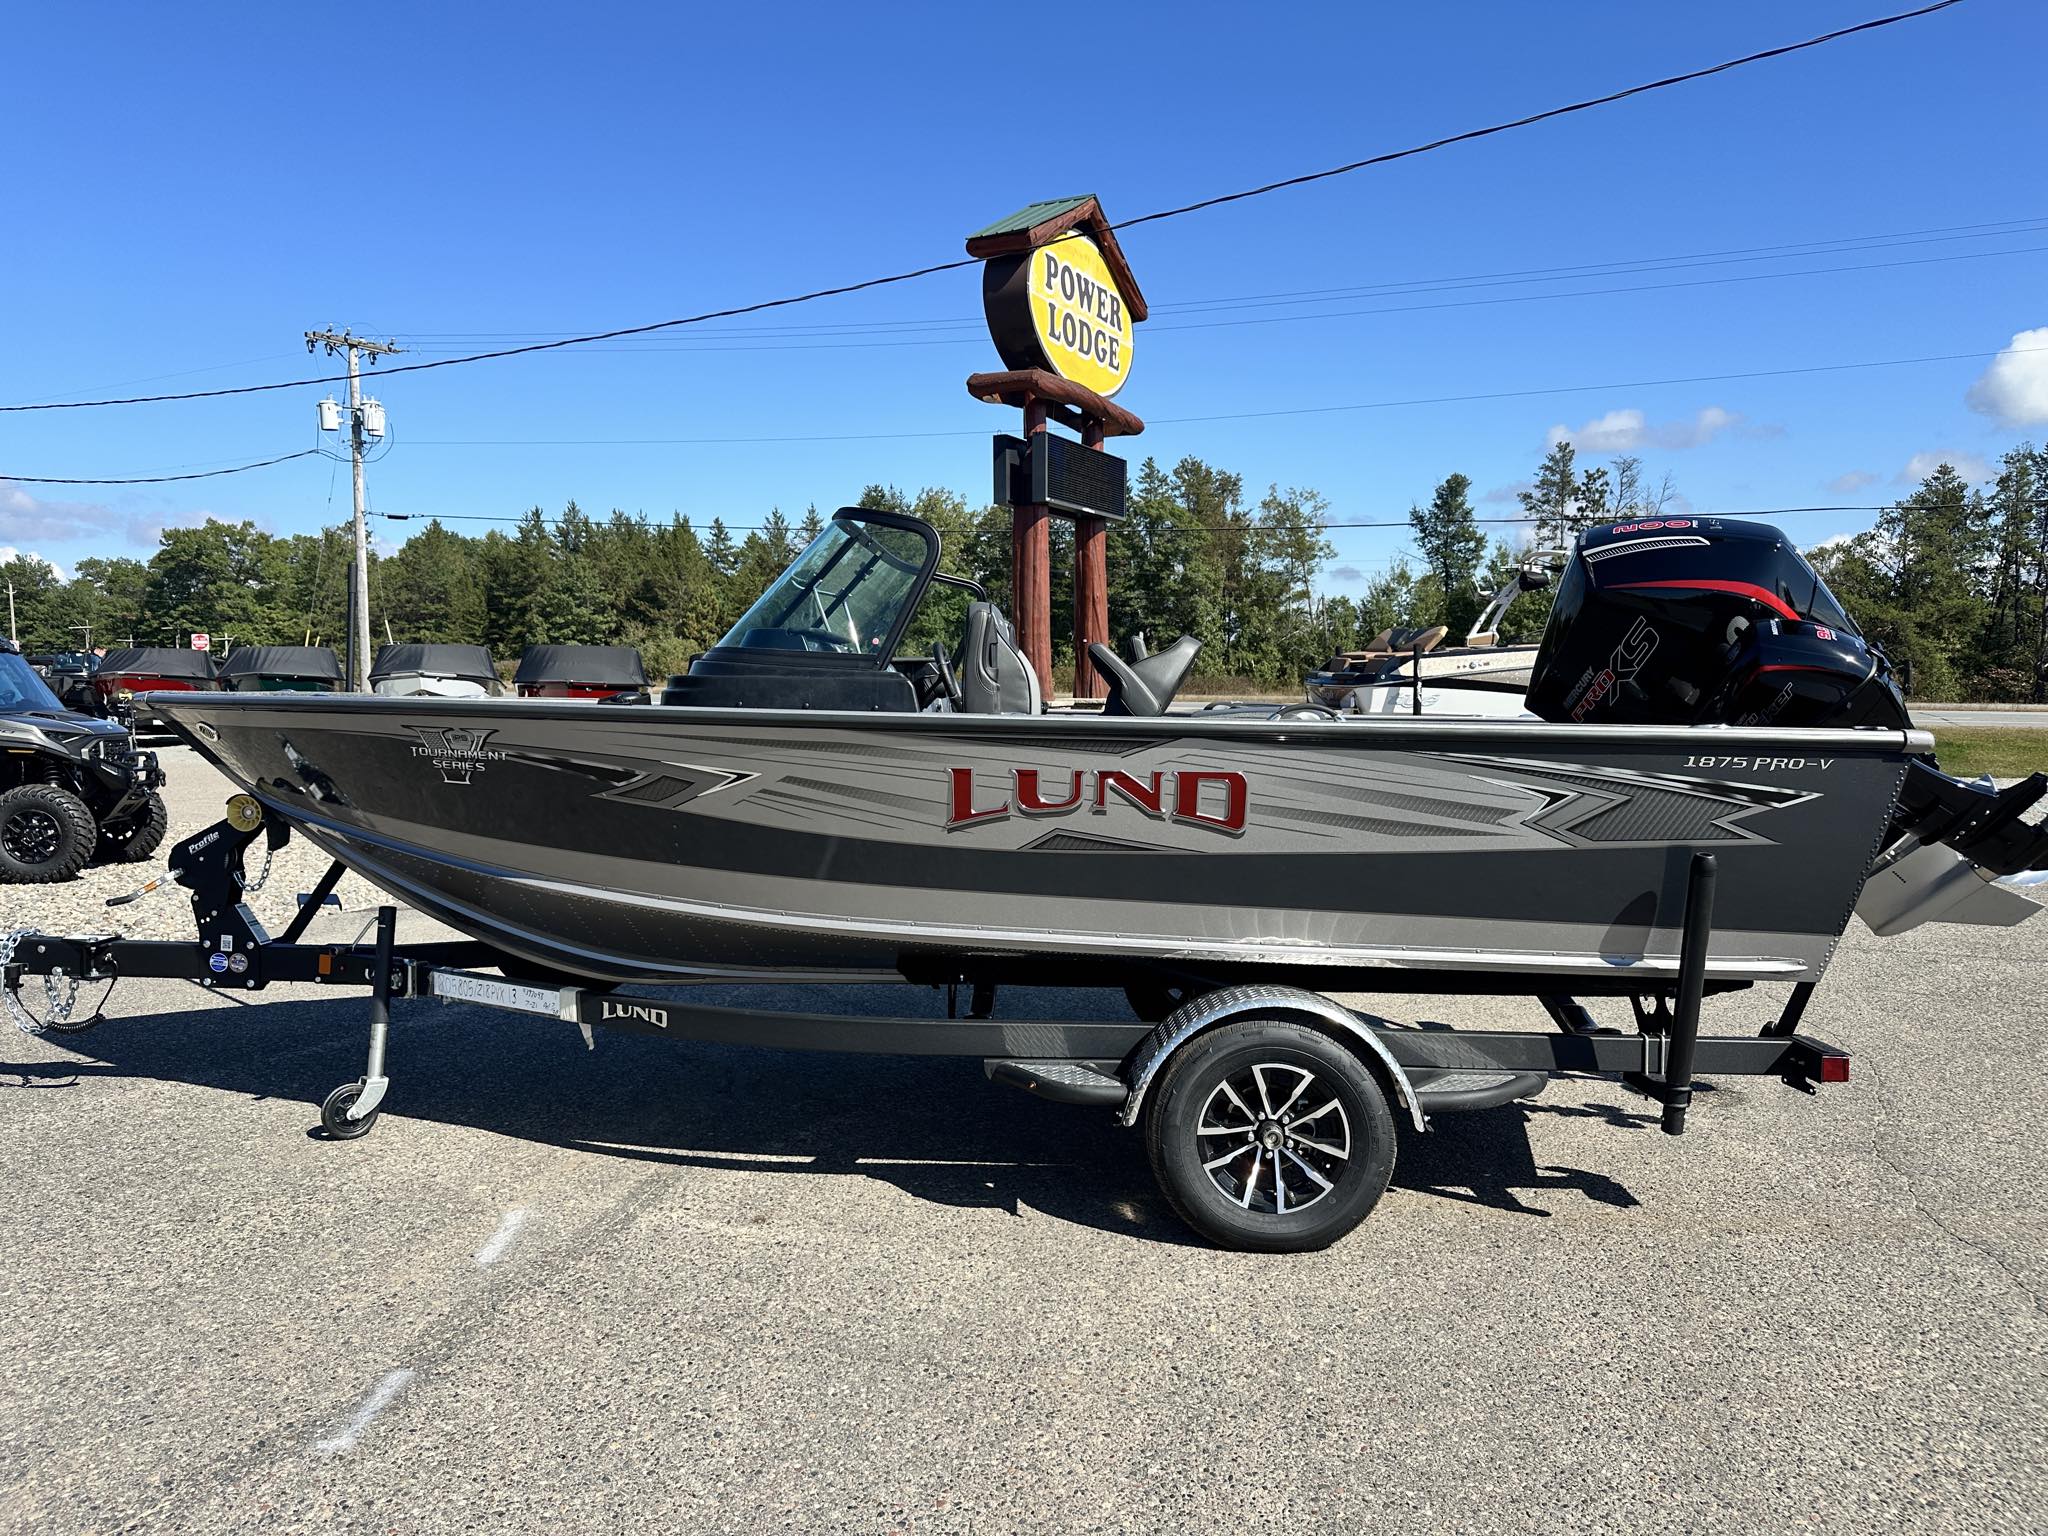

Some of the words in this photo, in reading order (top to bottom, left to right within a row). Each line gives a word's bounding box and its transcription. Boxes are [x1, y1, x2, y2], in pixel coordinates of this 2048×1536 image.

[1044, 252, 1123, 333] POWER
[1048, 301, 1121, 372] LODGE
[1609, 615, 1660, 706] XS
[410, 746, 507, 760] TOURNAMENT
[432, 759, 486, 772] SERIES
[1683, 756, 1748, 768] 1875
[1752, 757, 1834, 771] PRO-V
[945, 768, 1247, 834] LUND
[188, 831, 219, 852] Profile
[602, 1001, 668, 1028] LUND
